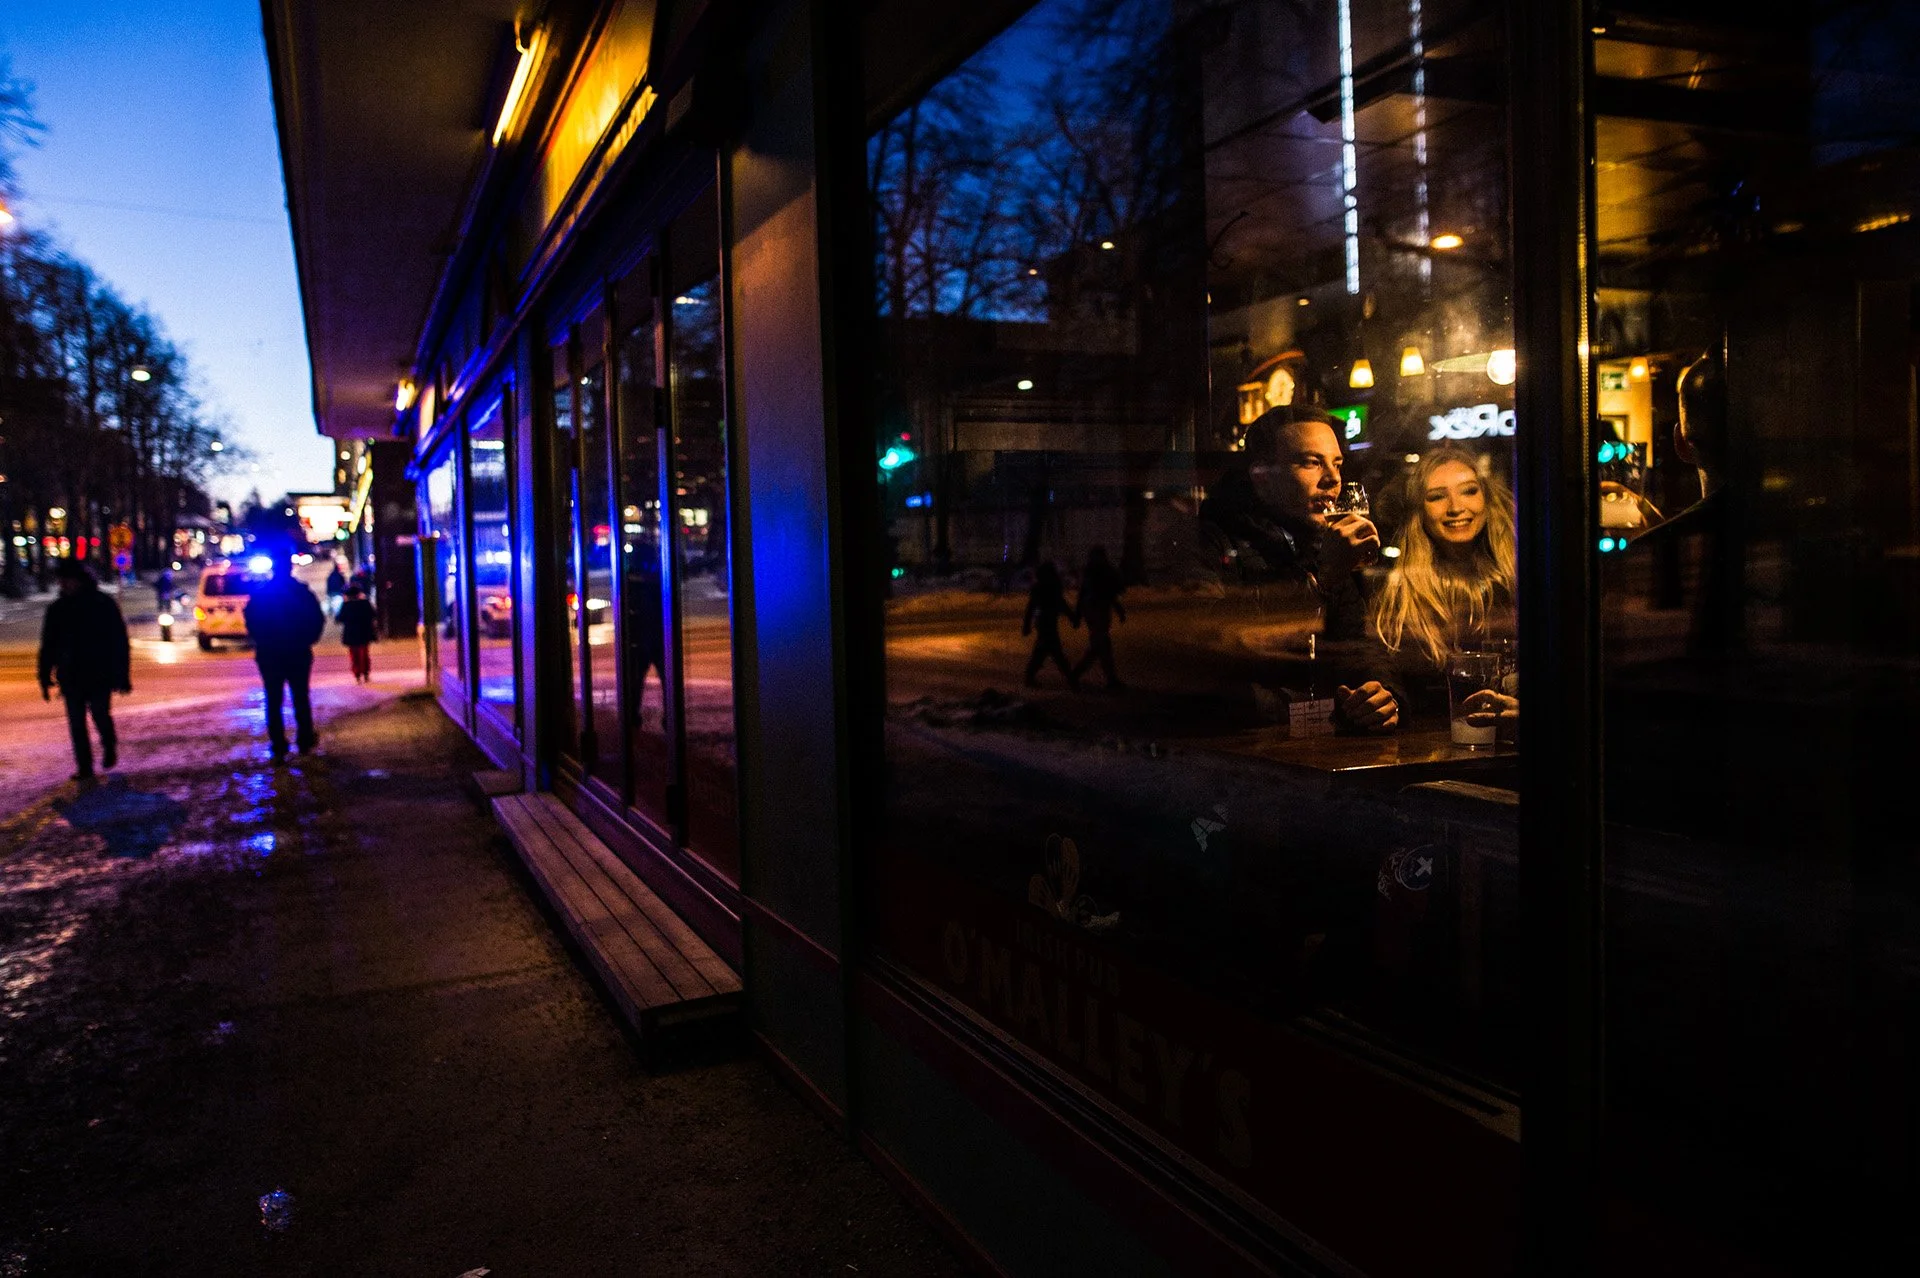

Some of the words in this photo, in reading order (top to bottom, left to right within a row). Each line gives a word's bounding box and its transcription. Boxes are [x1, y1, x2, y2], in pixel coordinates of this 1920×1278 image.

[1014, 918, 1068, 974] IRISH
[1075, 946, 1121, 997] PUB
[940, 917, 1252, 1169] O'MALLEY'S
